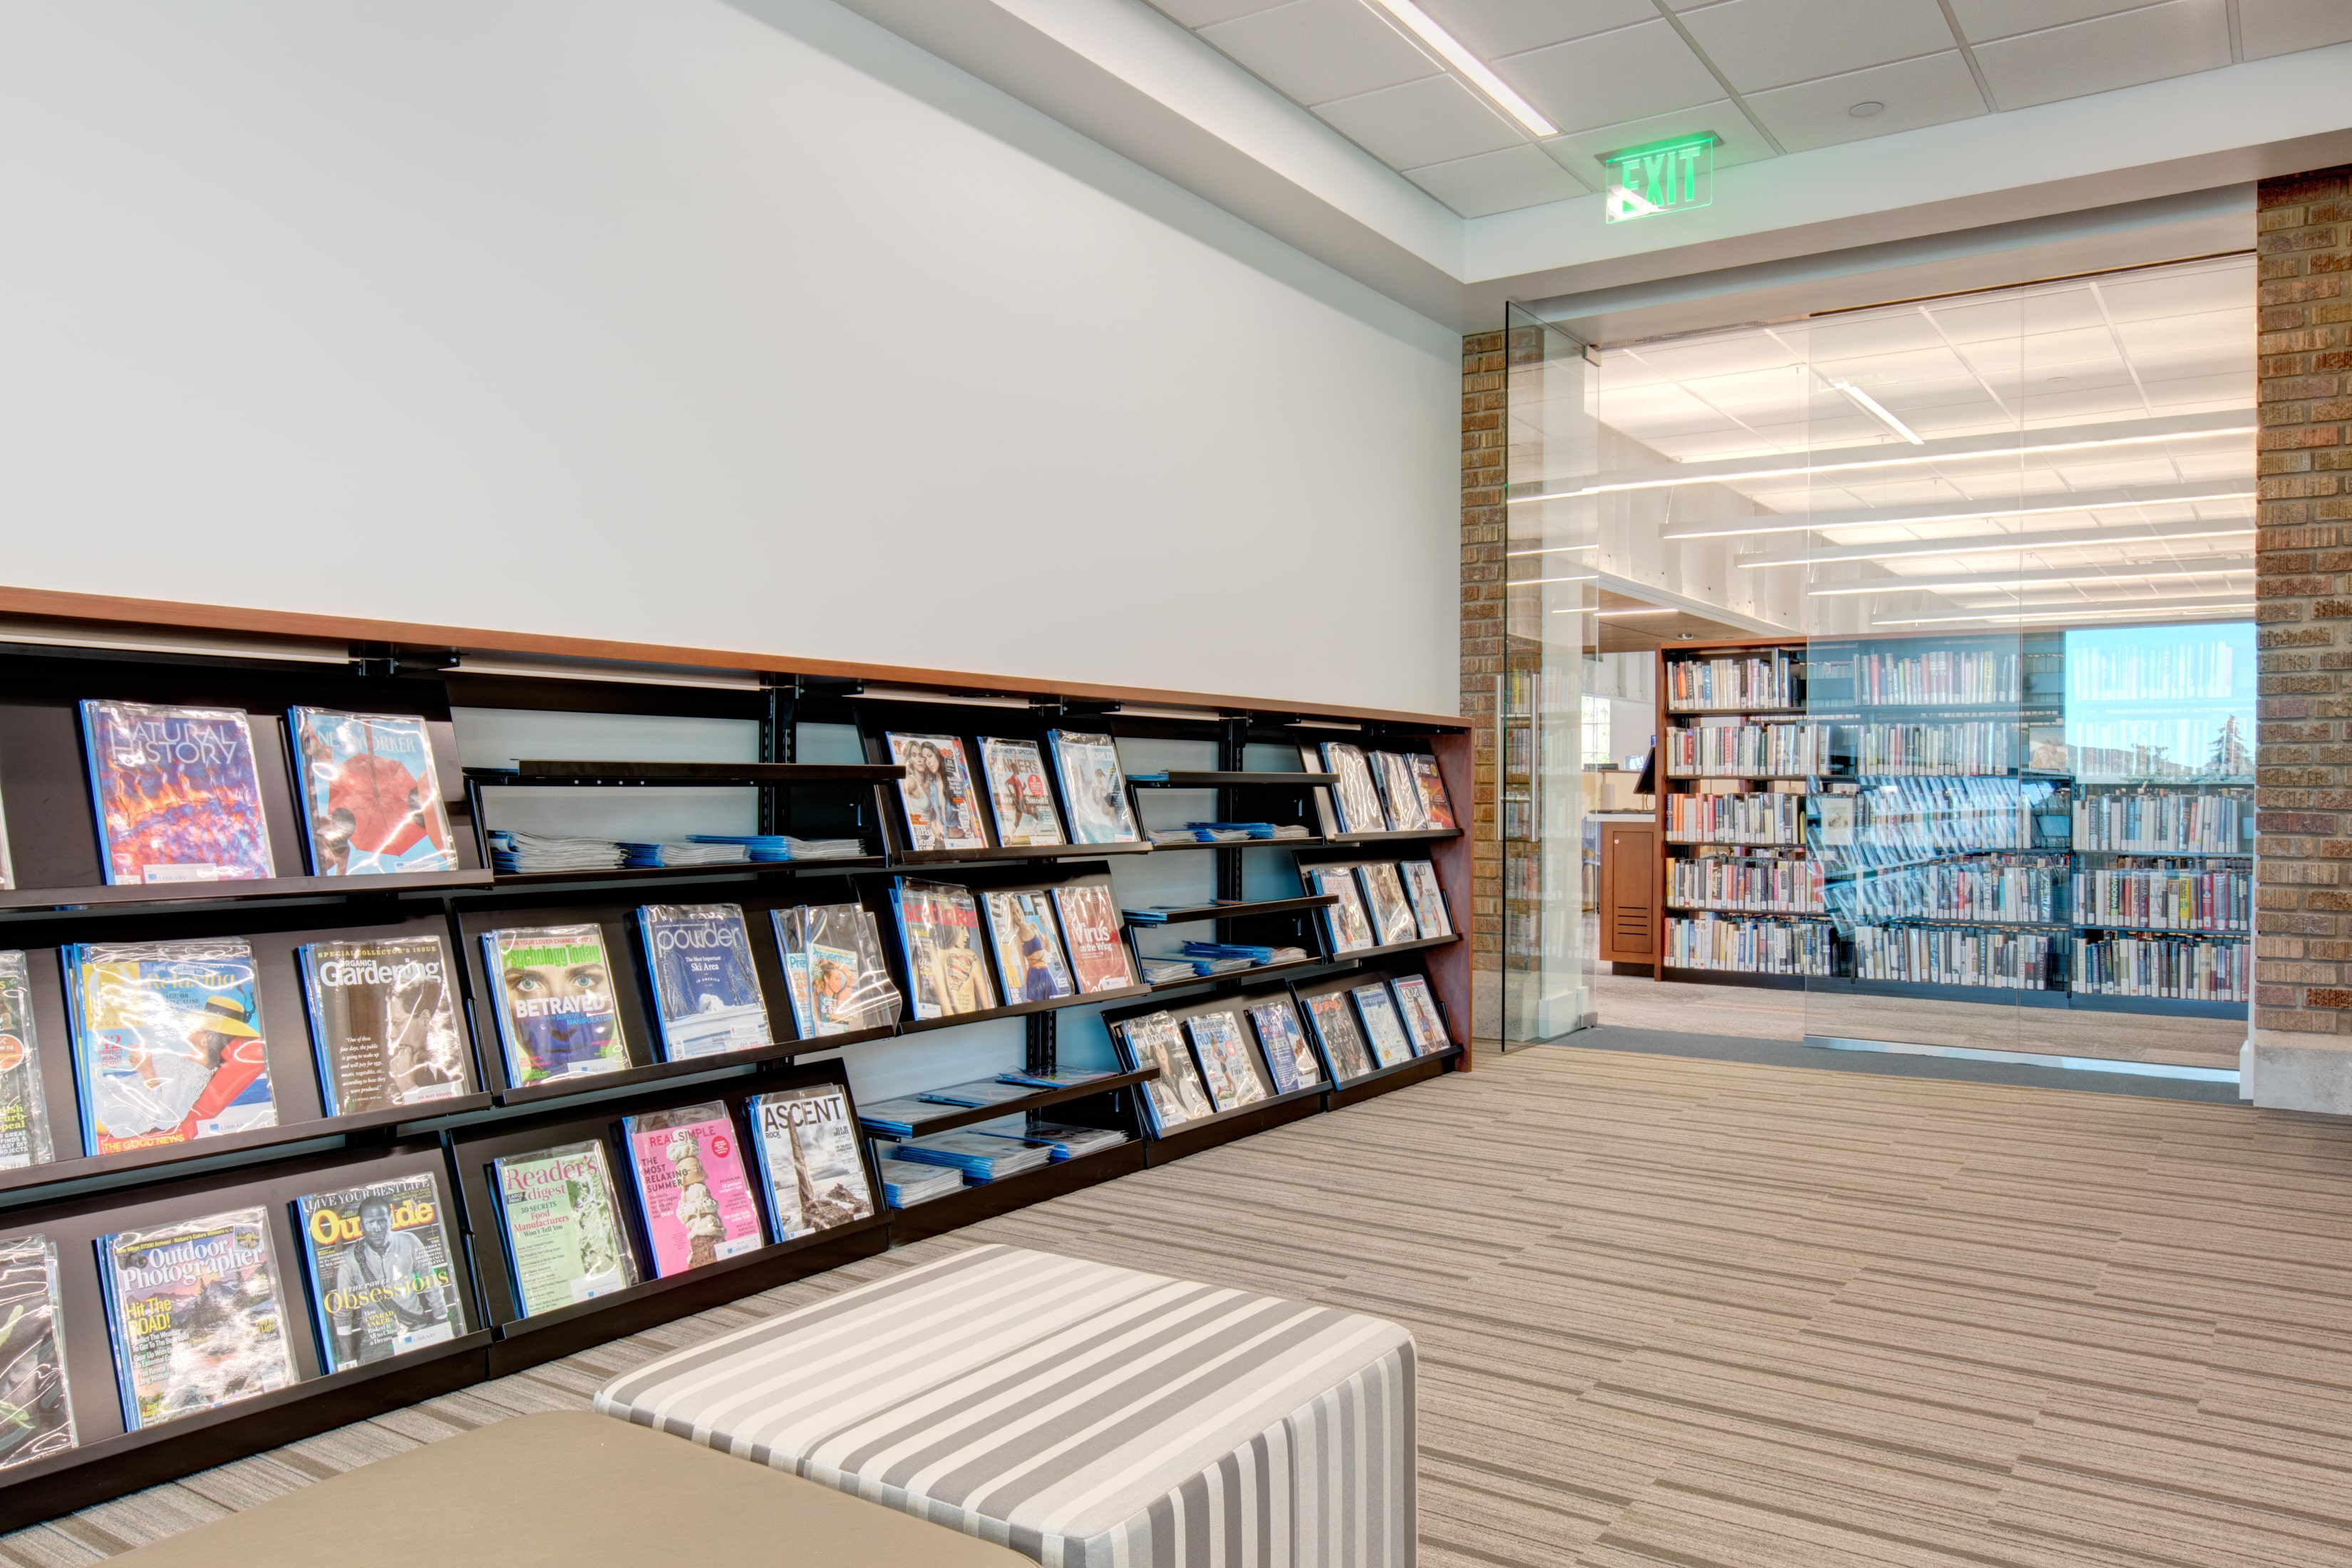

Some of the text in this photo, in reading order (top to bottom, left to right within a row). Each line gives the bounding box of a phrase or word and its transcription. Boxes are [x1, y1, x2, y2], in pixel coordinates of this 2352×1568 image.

[1622, 146, 1701, 214] EXIT
[108, 718, 237, 744] NATURAL
[112, 739, 237, 764] HISTORY
[656, 922, 740, 958] powder
[1072, 923, 1110, 943] Virus
[358, 947, 410, 956] COLLECTOR'S
[1097, 942, 1112, 951] Wing
[504, 944, 601, 969] Psychology Today
[320, 958, 442, 987] Gardening
[691, 963, 702, 971] Ski
[146, 972, 235, 990] Relaxing
[514, 993, 604, 1018] BETRAYED
[567, 1015, 613, 1026] MANIPULATOR
[103, 1035, 122, 1050] 12
[765, 1096, 840, 1132] ASCENT
[103, 1133, 185, 1151] THE GOOD NEWS
[649, 1125, 716, 1147] REAL SIMPLE
[642, 1157, 658, 1167] THE
[644, 1165, 666, 1175] MOST
[507, 1155, 597, 1191] Reader's
[646, 1169, 688, 1184] RELAXING
[309, 1179, 430, 1209] LIVE YOUR BEST LIFE
[527, 1184, 566, 1202] digest
[647, 1180, 684, 1193] SUMMER
[530, 1201, 557, 1212] SECRETS
[530, 1209, 550, 1220] Food
[514, 1215, 569, 1232] Manufacturers
[155, 1239, 172, 1248] Arrives!
[207, 1229, 225, 1237] Winners
[148, 1239, 228, 1269] Outdoor
[418, 1247, 442, 1256] SYNDROME
[123, 1249, 263, 1292] Photographer
[366, 1277, 391, 1288] POWER
[324, 1271, 449, 1314] Obsessions
[125, 1297, 172, 1319] Hit The
[365, 1311, 394, 1322] CONRAD
[367, 1318, 391, 1328] ANKER
[368, 1326, 384, 1334] Risked
[413, 1334, 436, 1342] LIBRARY
[133, 1353, 146, 1362] Gear
[155, 1348, 167, 1357] With
[143, 1356, 165, 1367] Essential
